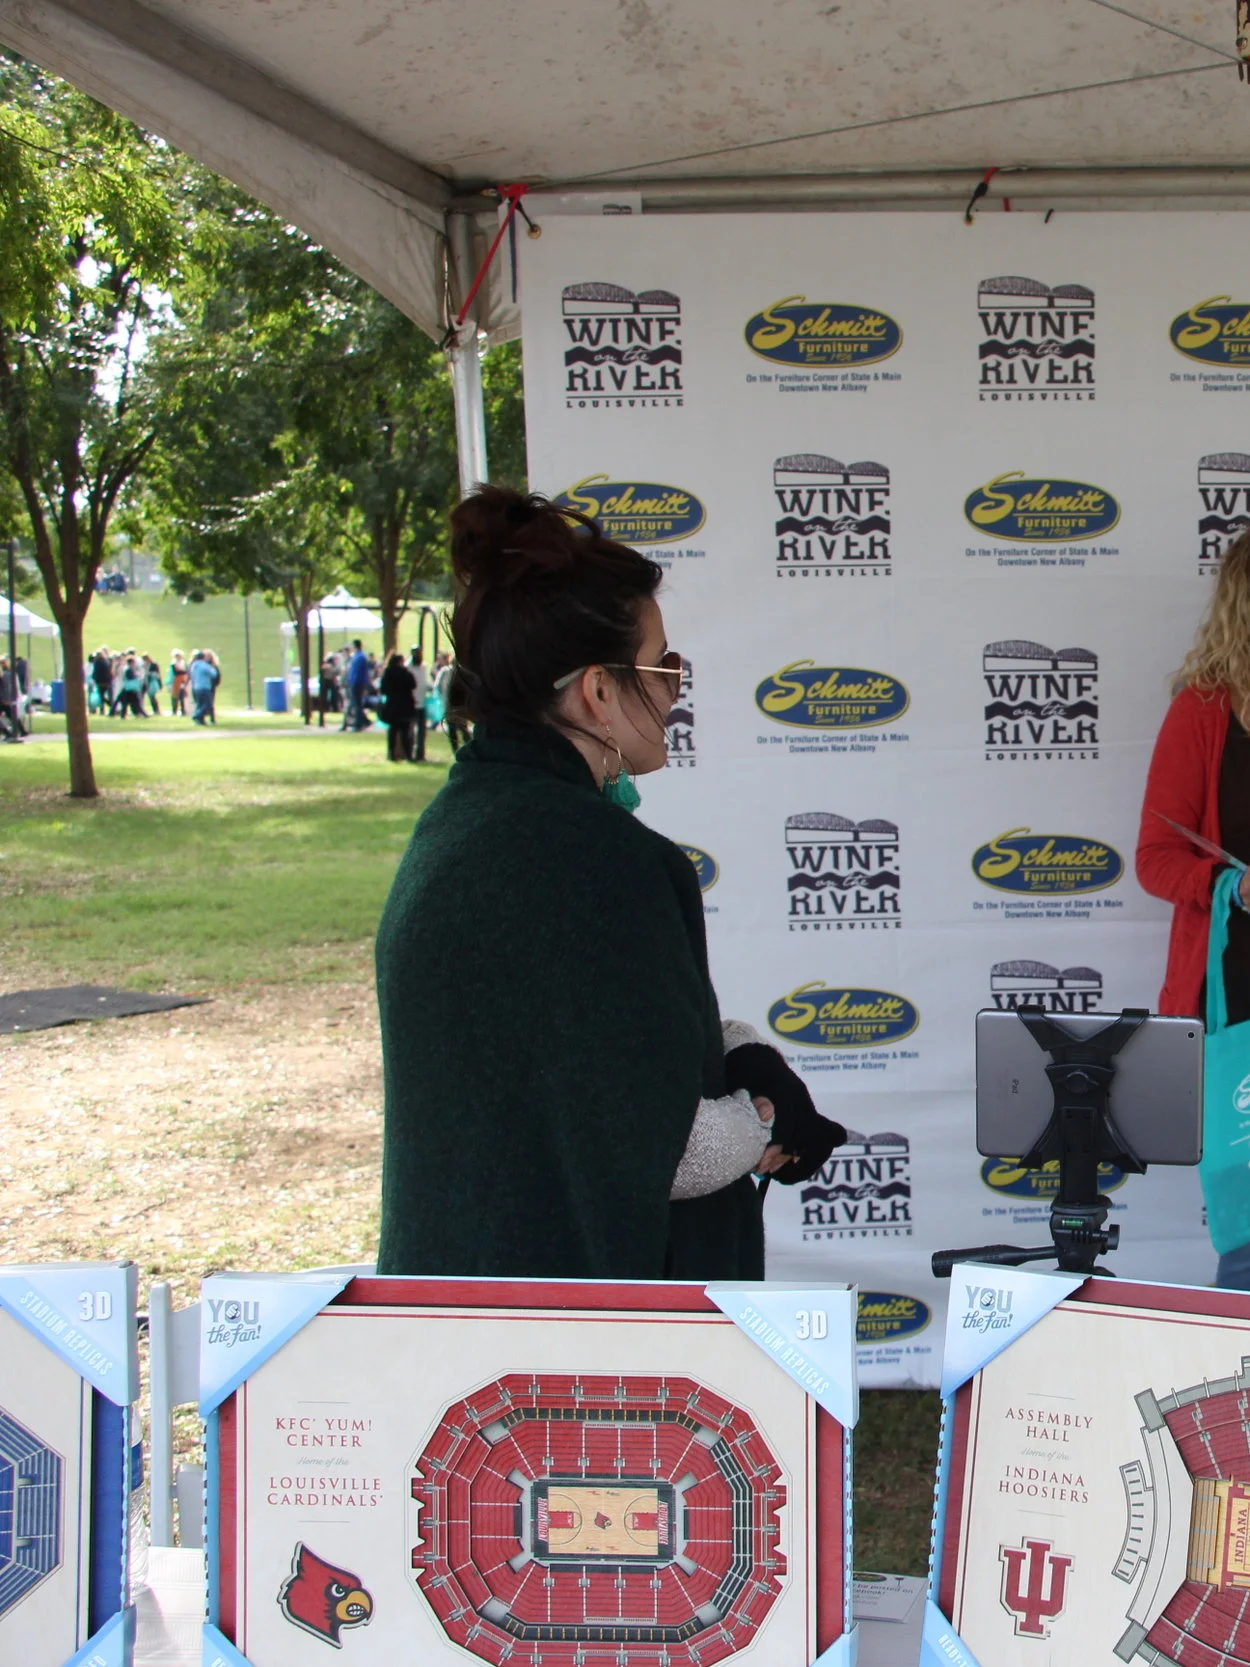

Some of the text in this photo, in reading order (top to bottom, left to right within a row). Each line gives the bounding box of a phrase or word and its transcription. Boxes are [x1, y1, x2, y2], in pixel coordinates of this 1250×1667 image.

[563, 317, 681, 346] WINE
[751, 297, 888, 349] Schmitt
[979, 311, 1094, 339] WINE
[594, 346, 648, 361] on the
[799, 341, 868, 353] Furniture
[1008, 340, 1061, 355] on the
[565, 365, 682, 391] RIVER
[746, 372, 902, 382] On the Furniture Corner of State & Main
[979, 358, 1094, 384] RIVER
[779, 383, 867, 393] Downtown New Albany
[566, 399, 683, 408] LOUISVILLE
[560, 473, 690, 528] Schmitt
[775, 488, 890, 516] WINE
[971, 473, 1106, 524] Schmitt
[603, 520, 672, 532] Furniture
[804, 517, 858, 532] on the
[1018, 516, 1086, 528] Furniture
[775, 535, 891, 561] RIVER
[776, 569, 891, 577] LOUISVILLE
[761, 660, 896, 712] Schmitt
[984, 674, 1098, 701] WINE
[808, 703, 876, 715] Furniture
[1013, 702, 1066, 716] on the
[984, 719, 1098, 744] RIVER
[985, 752, 1099, 760] LOUISVILLE
[786, 845, 899, 872] WINE
[978, 829, 1110, 878] Schmitt
[815, 872, 868, 887] on the
[1024, 870, 1091, 882] Furniture
[787, 889, 900, 915] RIVER
[1001, 901, 1035, 909] Furniture
[1074, 900, 1094, 908] State
[1097, 900, 1102, 908] &
[1005, 909, 1090, 919] Downtown New Albany
[789, 922, 901, 931] LOUISVILLE
[774, 980, 904, 1032] Schmitt
[820, 1024, 888, 1036] Furniture
[1012, 1078, 1020, 1094] iPad
[802, 1200, 912, 1226] RIVER
[803, 1229, 912, 1240] LOUISVILLE
[78, 1291, 112, 1322] 3D
[966, 1286, 1013, 1313] YOU
[208, 1299, 260, 1325] YOU
[962, 1311, 1013, 1334] the fan!
[19, 1291, 114, 1376] STADIUM REPLICAS
[207, 1324, 262, 1348] the fan!
[795, 1310, 828, 1340] 3D
[739, 1306, 830, 1395] STADIUM REPLICAS
[324, 1418, 373, 1432] YUM!
[1005, 1408, 1094, 1430] ASSEMBLY
[286, 1434, 362, 1448] CENTER
[1026, 1426, 1070, 1443] HALL
[297, 1456, 324, 1466] Home
[335, 1456, 350, 1466] the
[1021, 1447, 1047, 1459] Home
[1058, 1452, 1070, 1462] the
[270, 1476, 382, 1490] LOUISVILLE
[1005, 1464, 1085, 1488] INDIANA
[998, 1481, 1089, 1504] HOOSIERS
[1234, 1508, 1248, 1563] INDIANA
